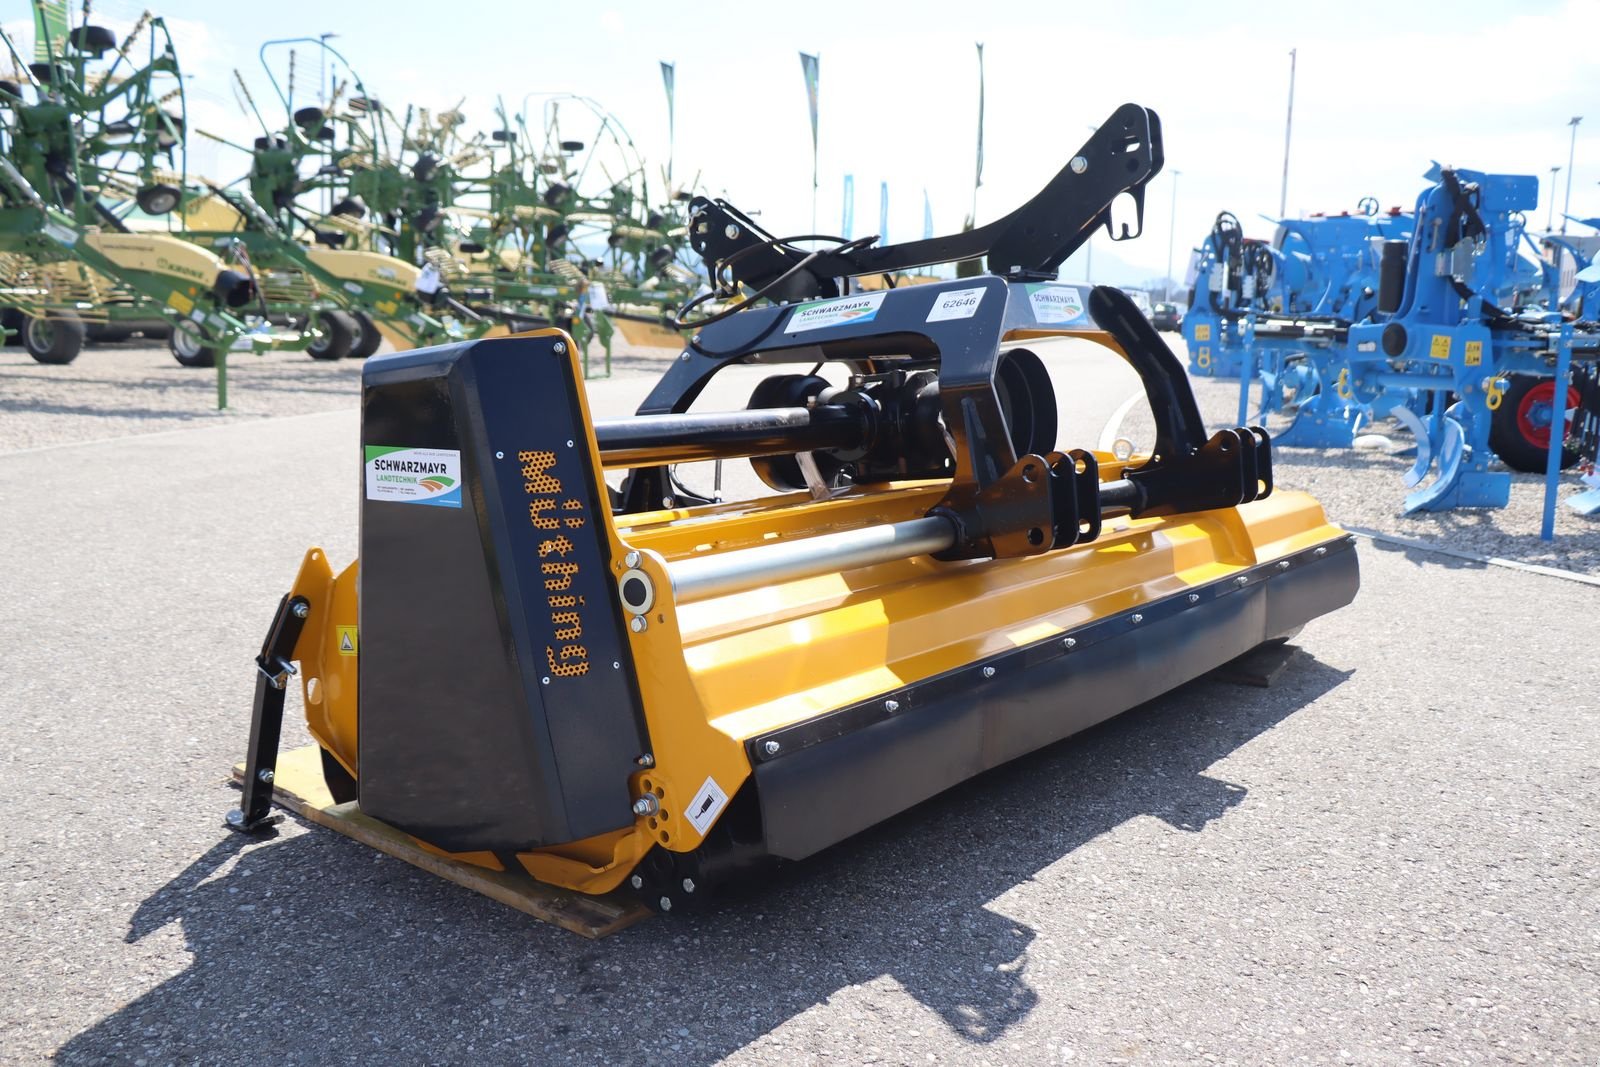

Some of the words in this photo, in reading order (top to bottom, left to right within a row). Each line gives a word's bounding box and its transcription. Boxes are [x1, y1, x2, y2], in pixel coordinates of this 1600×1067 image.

[942, 297, 977, 309] 62646
[1033, 294, 1075, 303] SCHWARZMAYR
[801, 301, 870, 317] SCHWARZMAYR
[374, 459, 447, 475] SCHWARZMAYR
[376, 474, 418, 485] LANDTECHNIK
[518, 450, 590, 677] Müthing
